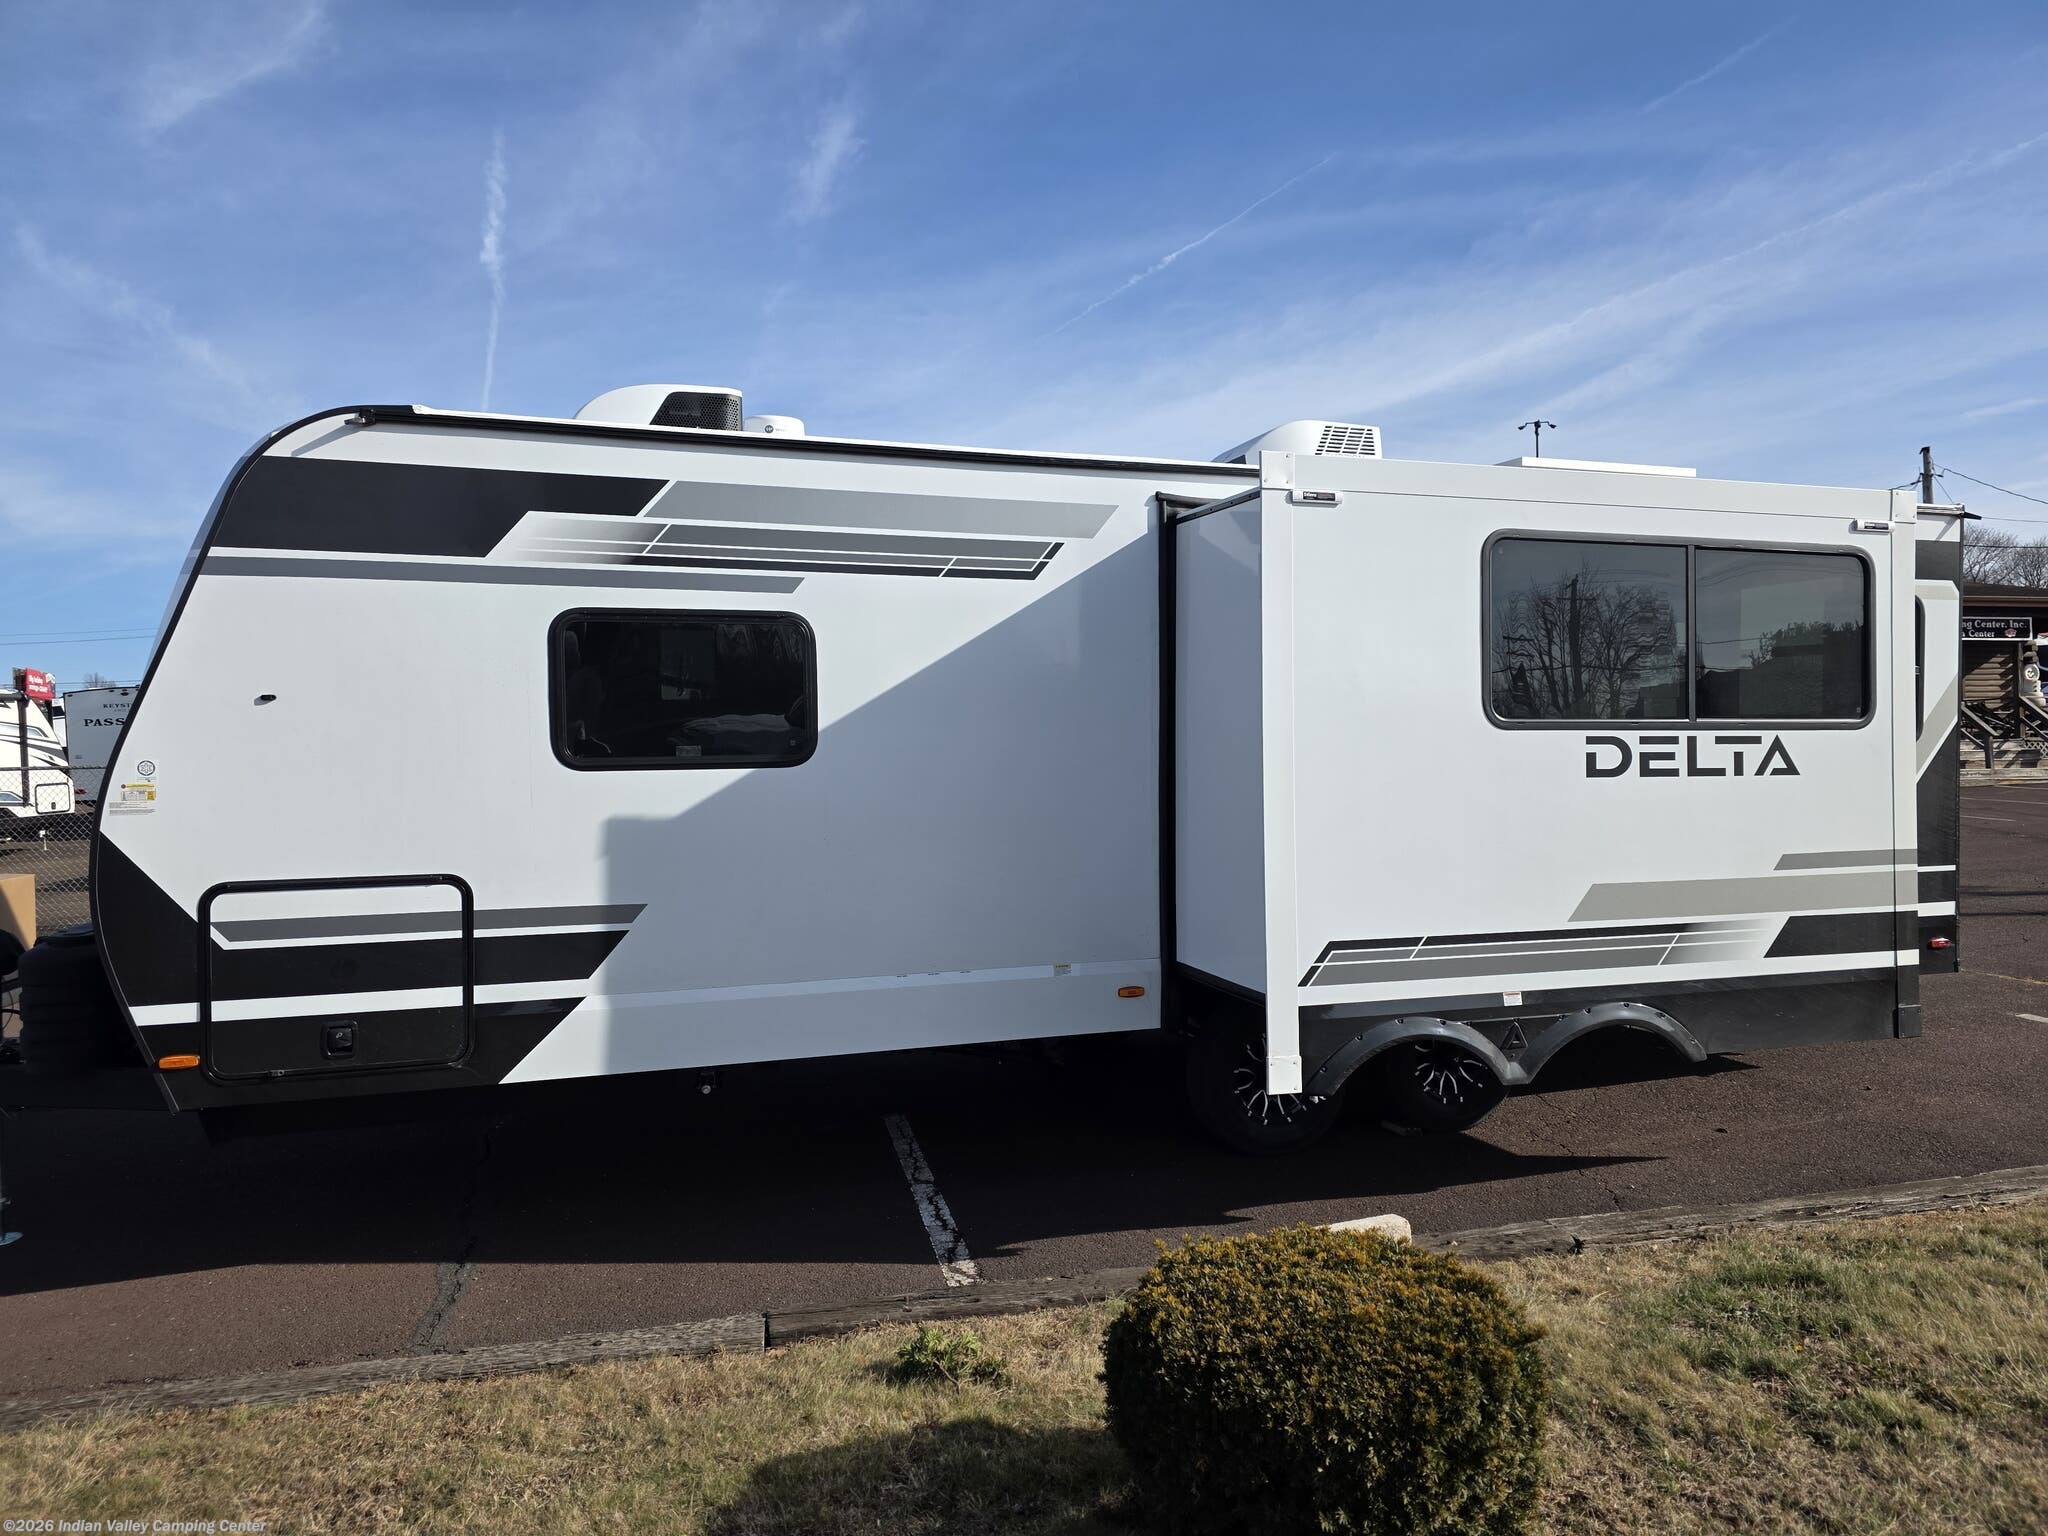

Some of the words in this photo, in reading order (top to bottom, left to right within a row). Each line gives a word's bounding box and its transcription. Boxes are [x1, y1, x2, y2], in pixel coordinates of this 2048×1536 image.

[2009, 620, 2028, 628] Inc.
[84, 718, 126, 727] PASS
[1586, 735, 1801, 778] DELTA
